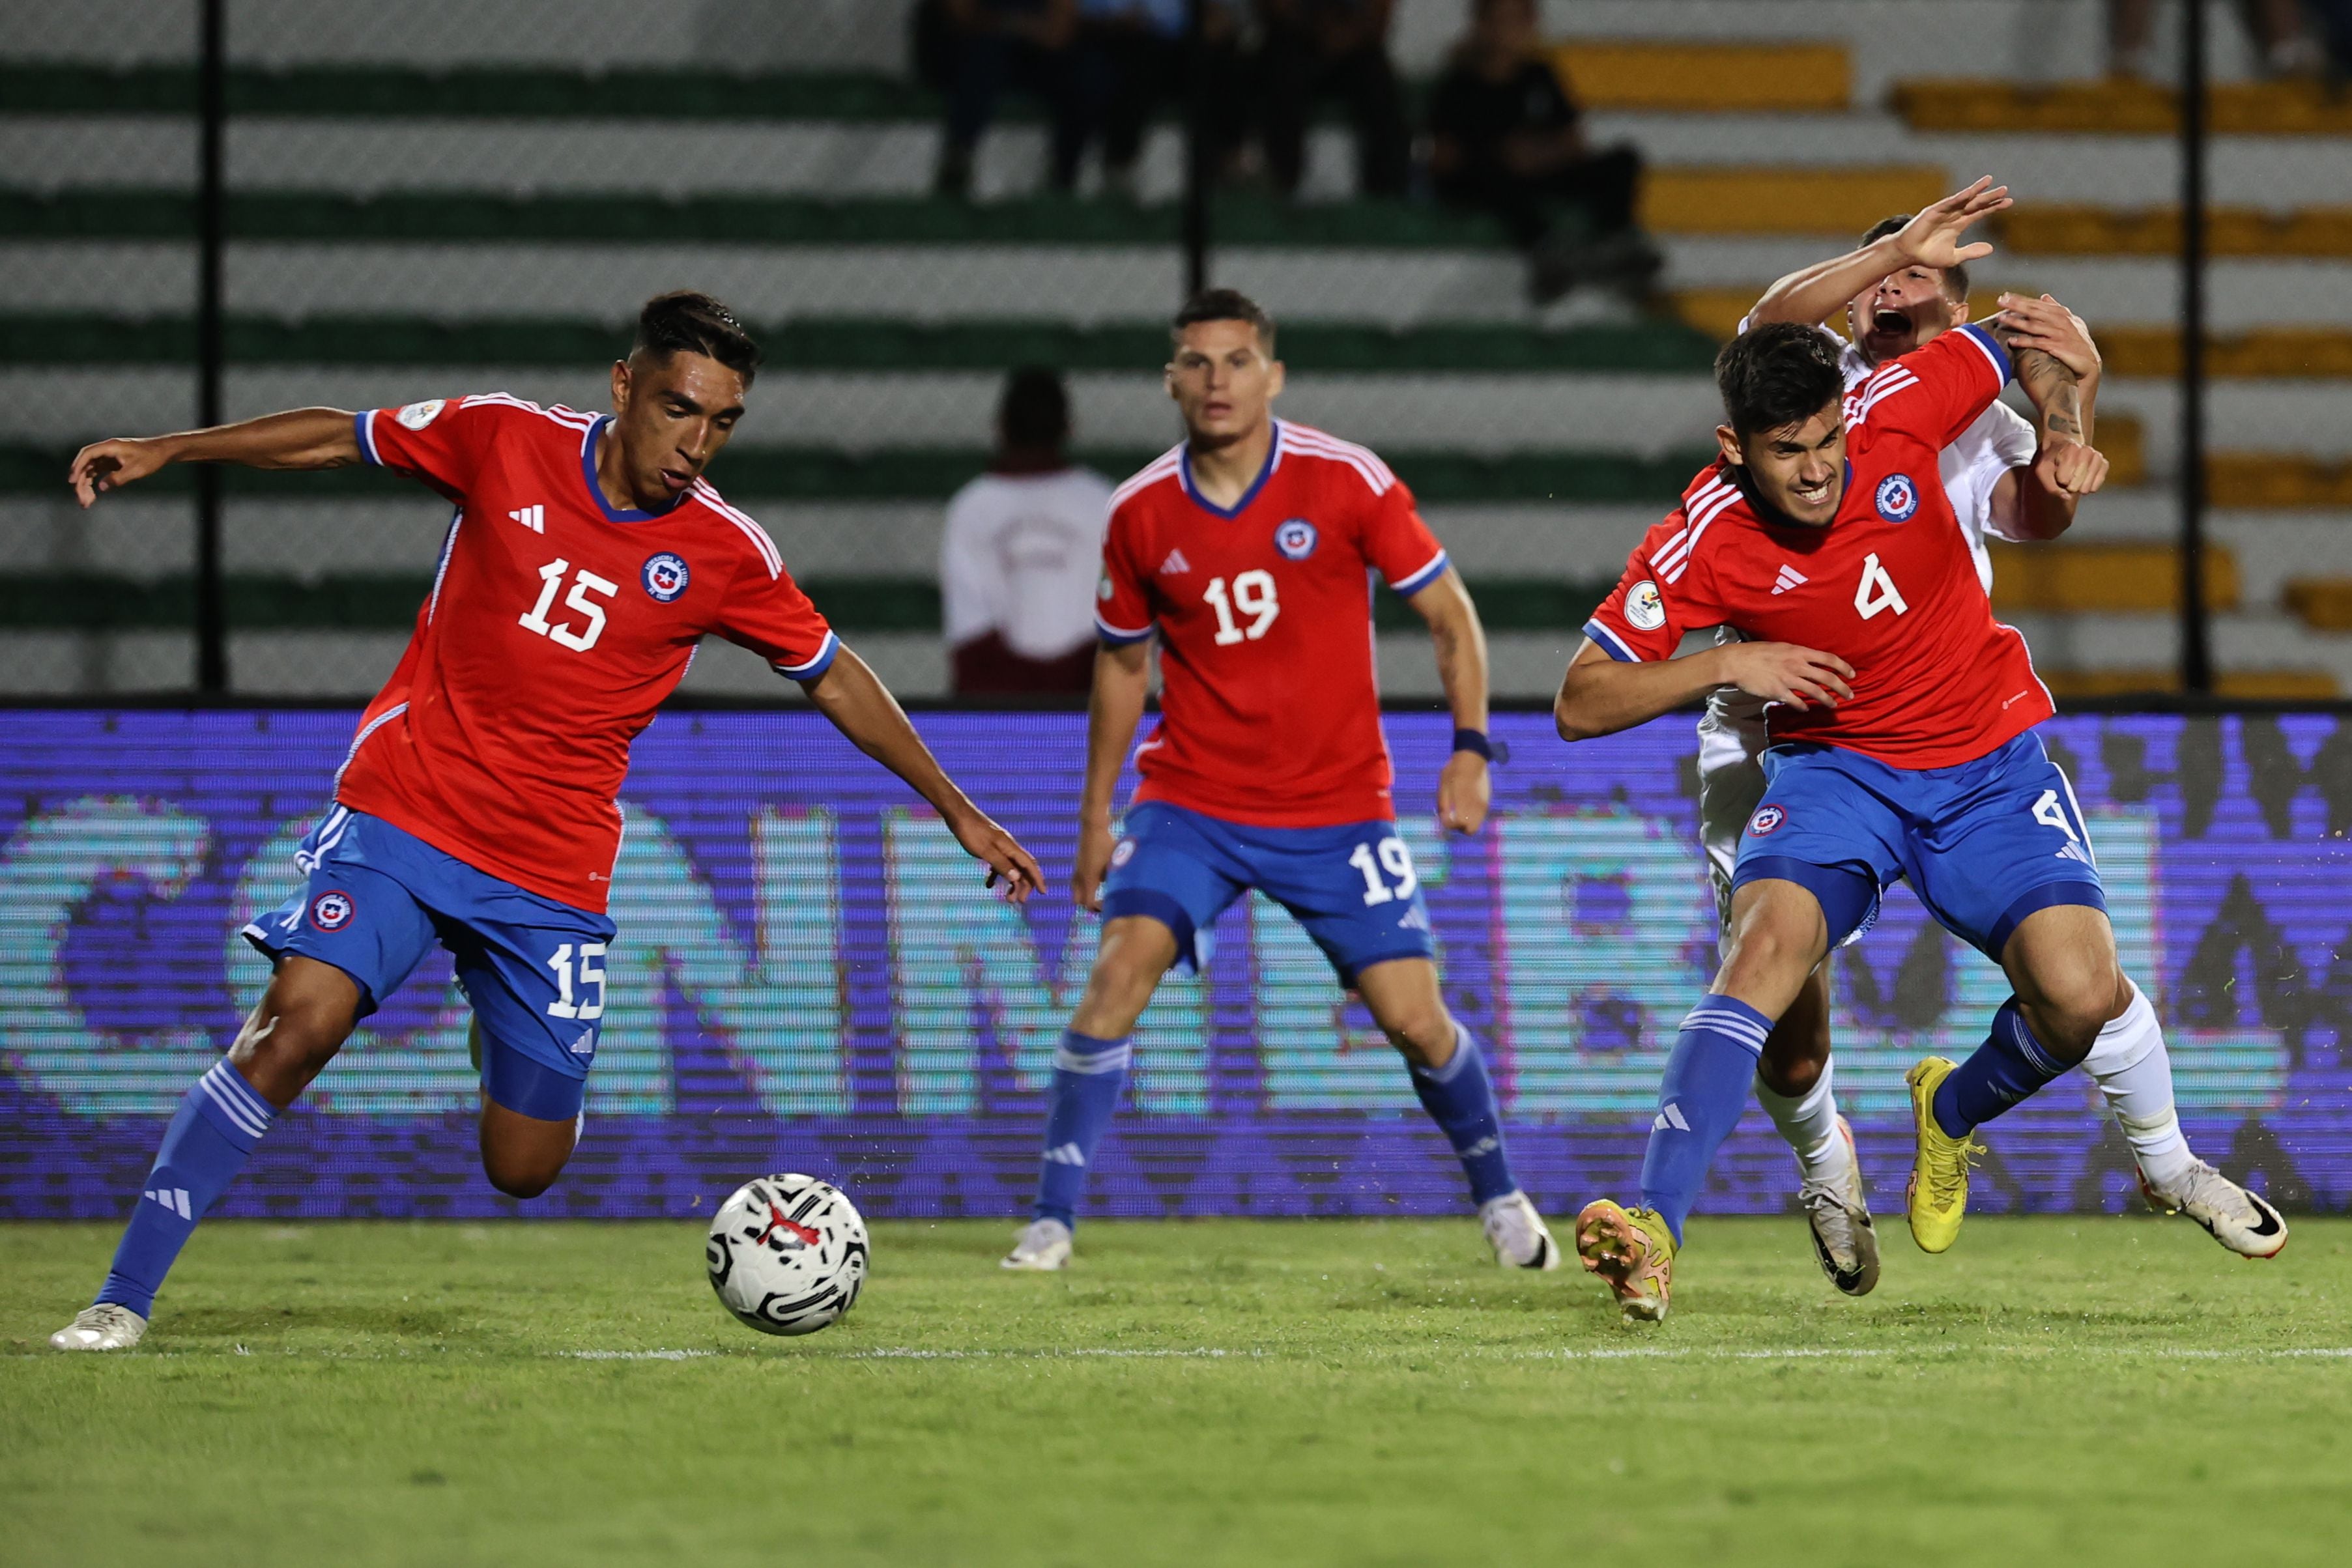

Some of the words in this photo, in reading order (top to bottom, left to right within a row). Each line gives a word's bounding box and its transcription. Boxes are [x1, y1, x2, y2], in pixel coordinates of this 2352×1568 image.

[518, 558, 618, 652] 15
[1204, 570, 1279, 645] 19
[1854, 552, 1908, 620] 4
[2031, 789, 2080, 842] 4
[1349, 836, 1417, 906] 19
[547, 942, 607, 1019] 15
